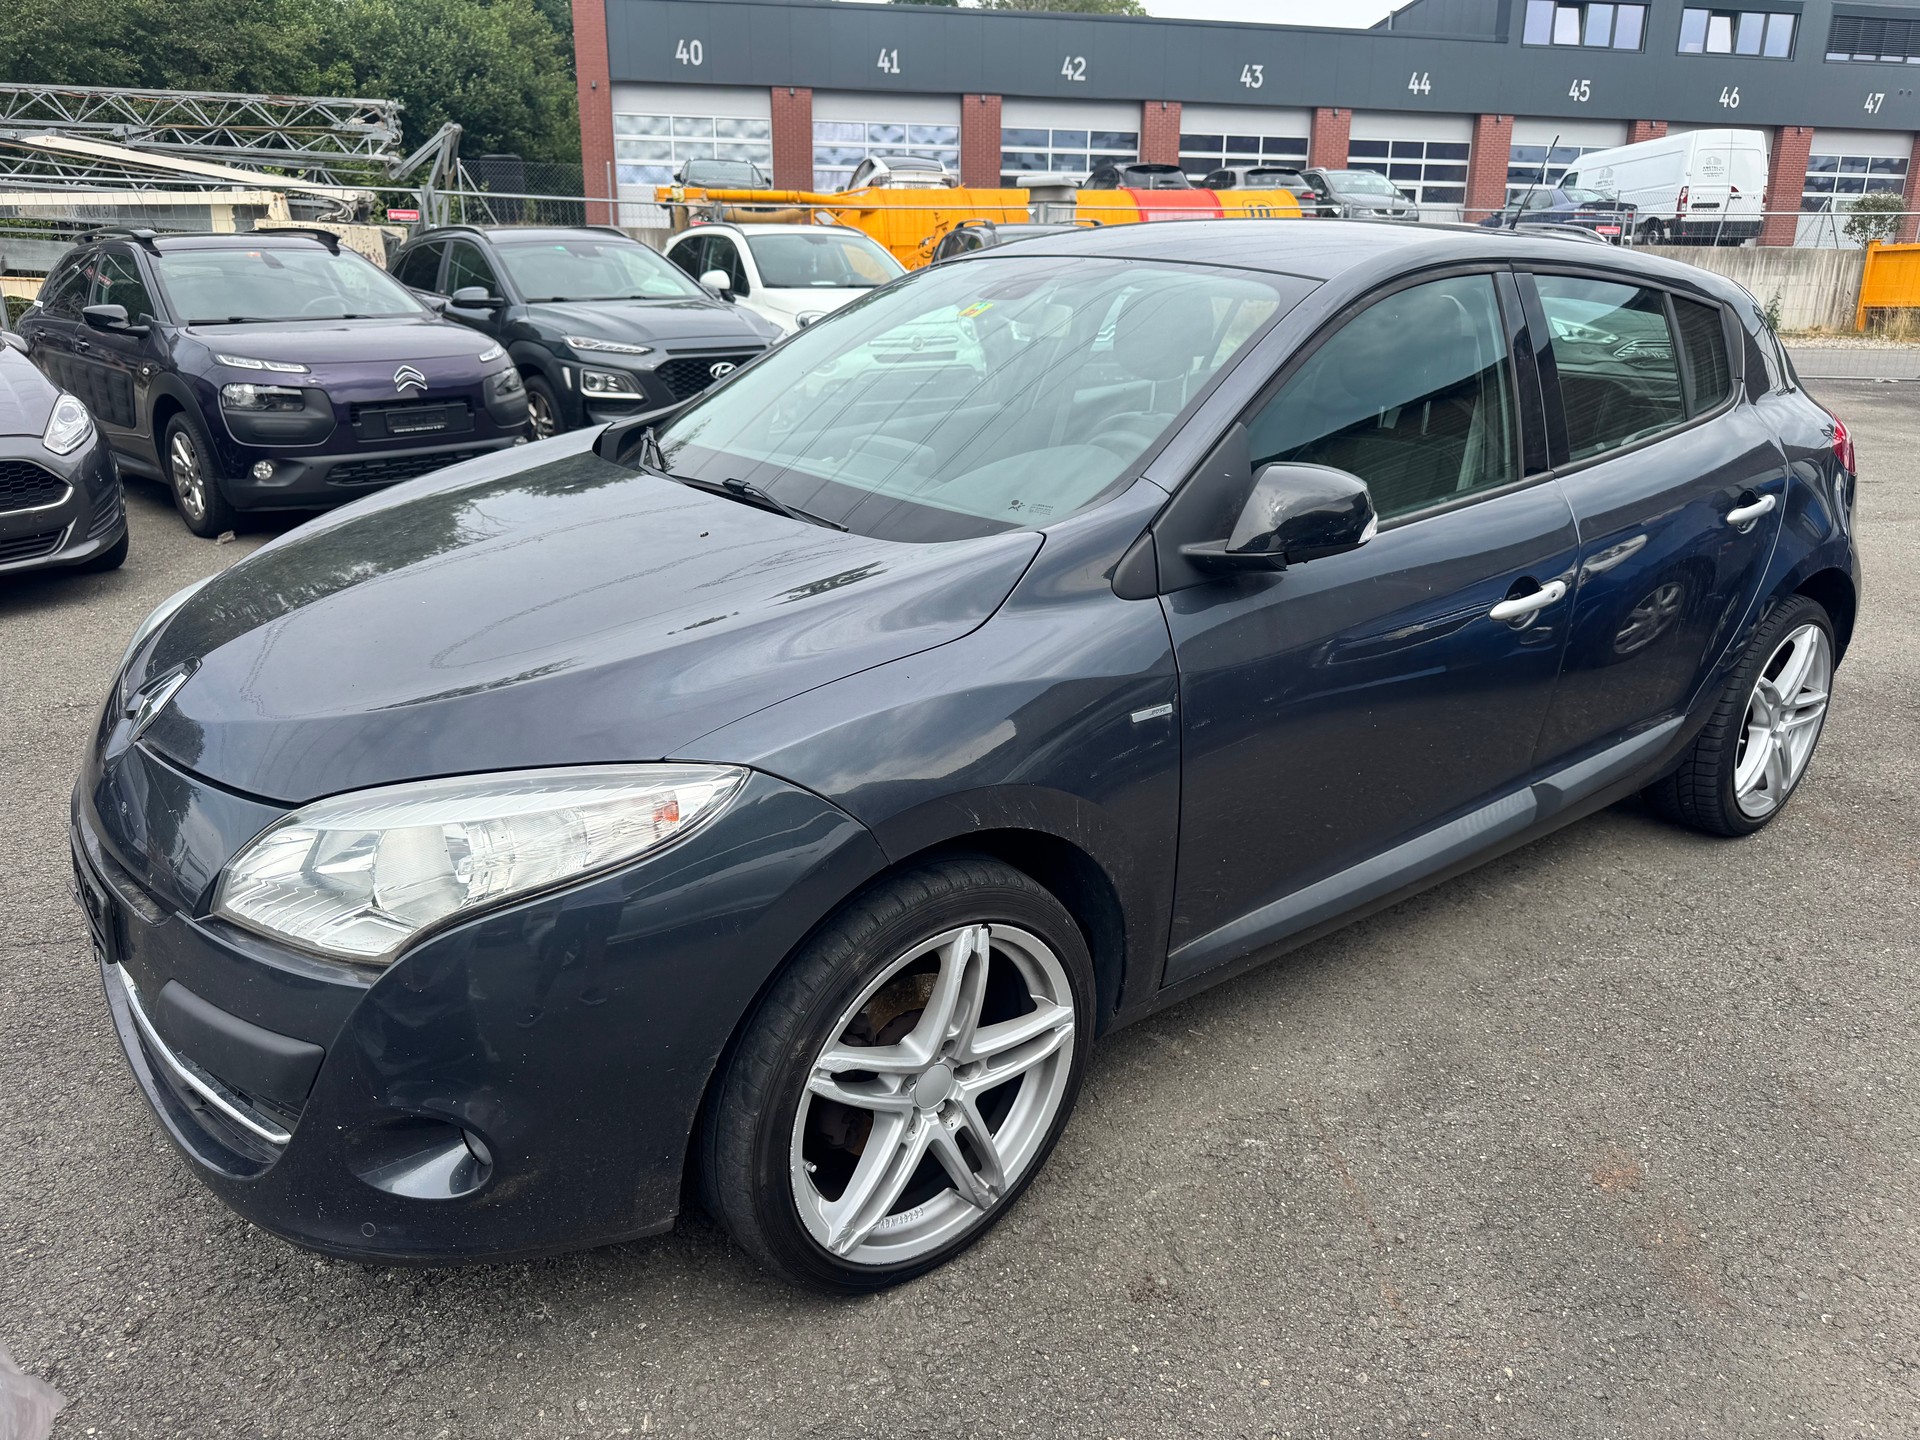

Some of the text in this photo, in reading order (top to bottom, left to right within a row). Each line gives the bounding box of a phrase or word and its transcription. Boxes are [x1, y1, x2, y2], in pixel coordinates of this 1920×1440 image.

[675, 39, 703, 66] 40
[876, 48, 901, 74] 41
[1060, 55, 1087, 82] 42
[1239, 64, 1264, 89] 43
[1407, 71, 1432, 96] 44
[1568, 79, 1591, 102] 45
[1718, 86, 1740, 109] 46
[1863, 92, 1886, 114] 47
